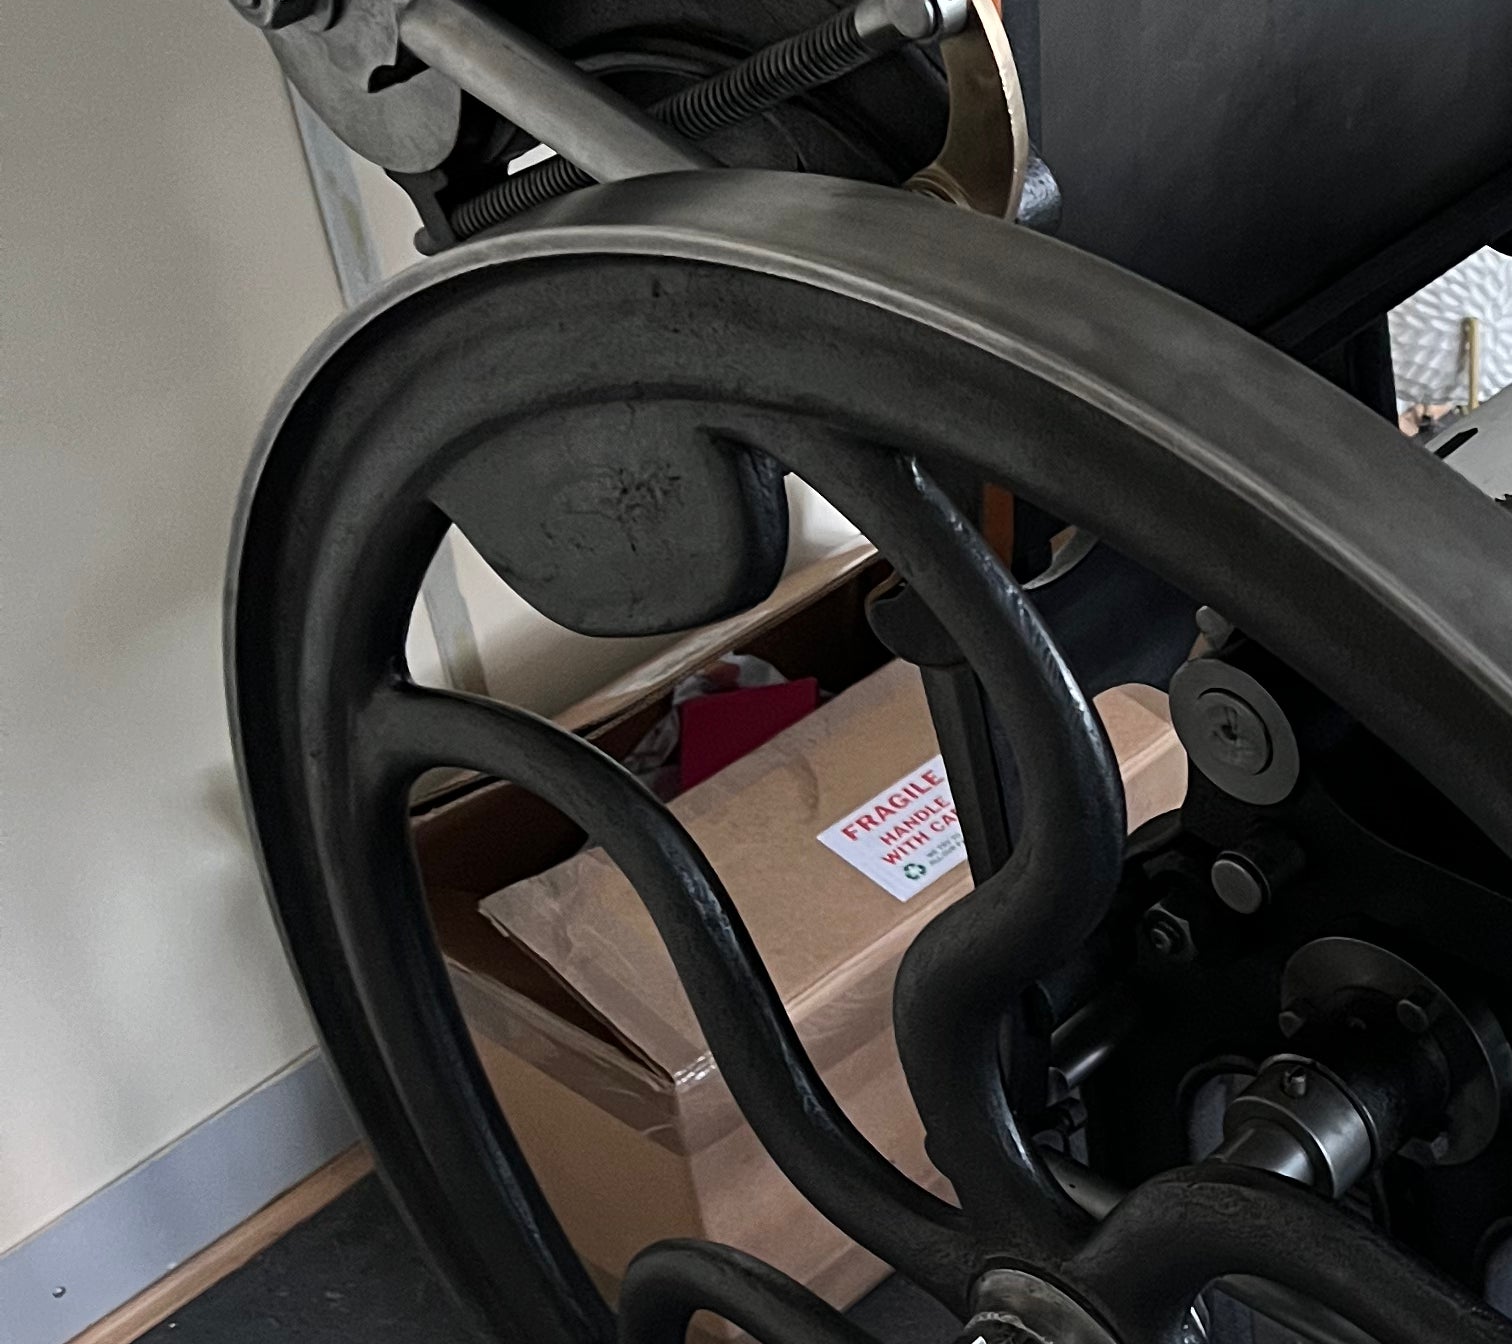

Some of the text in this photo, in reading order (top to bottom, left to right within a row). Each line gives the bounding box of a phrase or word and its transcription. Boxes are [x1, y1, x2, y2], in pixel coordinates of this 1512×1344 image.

[841, 769, 945, 841] FRAGILE
[879, 796, 951, 846] HANDLE
[881, 831, 931, 865] WITH
